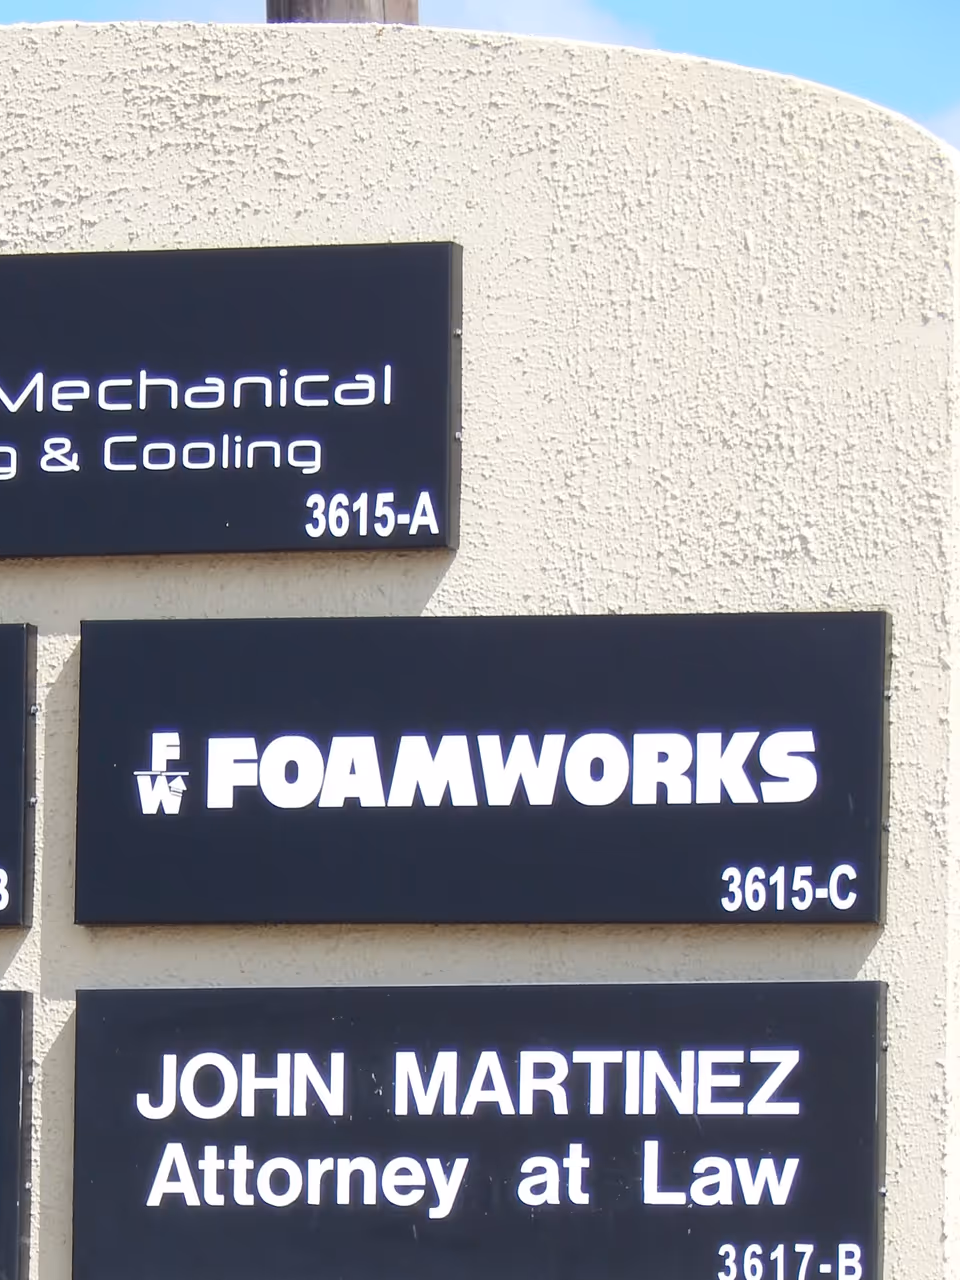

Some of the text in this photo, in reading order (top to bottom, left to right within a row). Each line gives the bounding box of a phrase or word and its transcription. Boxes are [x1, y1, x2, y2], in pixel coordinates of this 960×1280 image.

[39, 436, 81, 473] &
[103, 433, 322, 476] Cooling
[304, 490, 440, 539] 3615-A
[206, 730, 818, 809] FOAMWORKS
[720, 863, 858, 913] 3615-C
[136, 1049, 800, 1120] JOHN MARTINEZ
[145, 1139, 800, 1220] Attorney at Law
